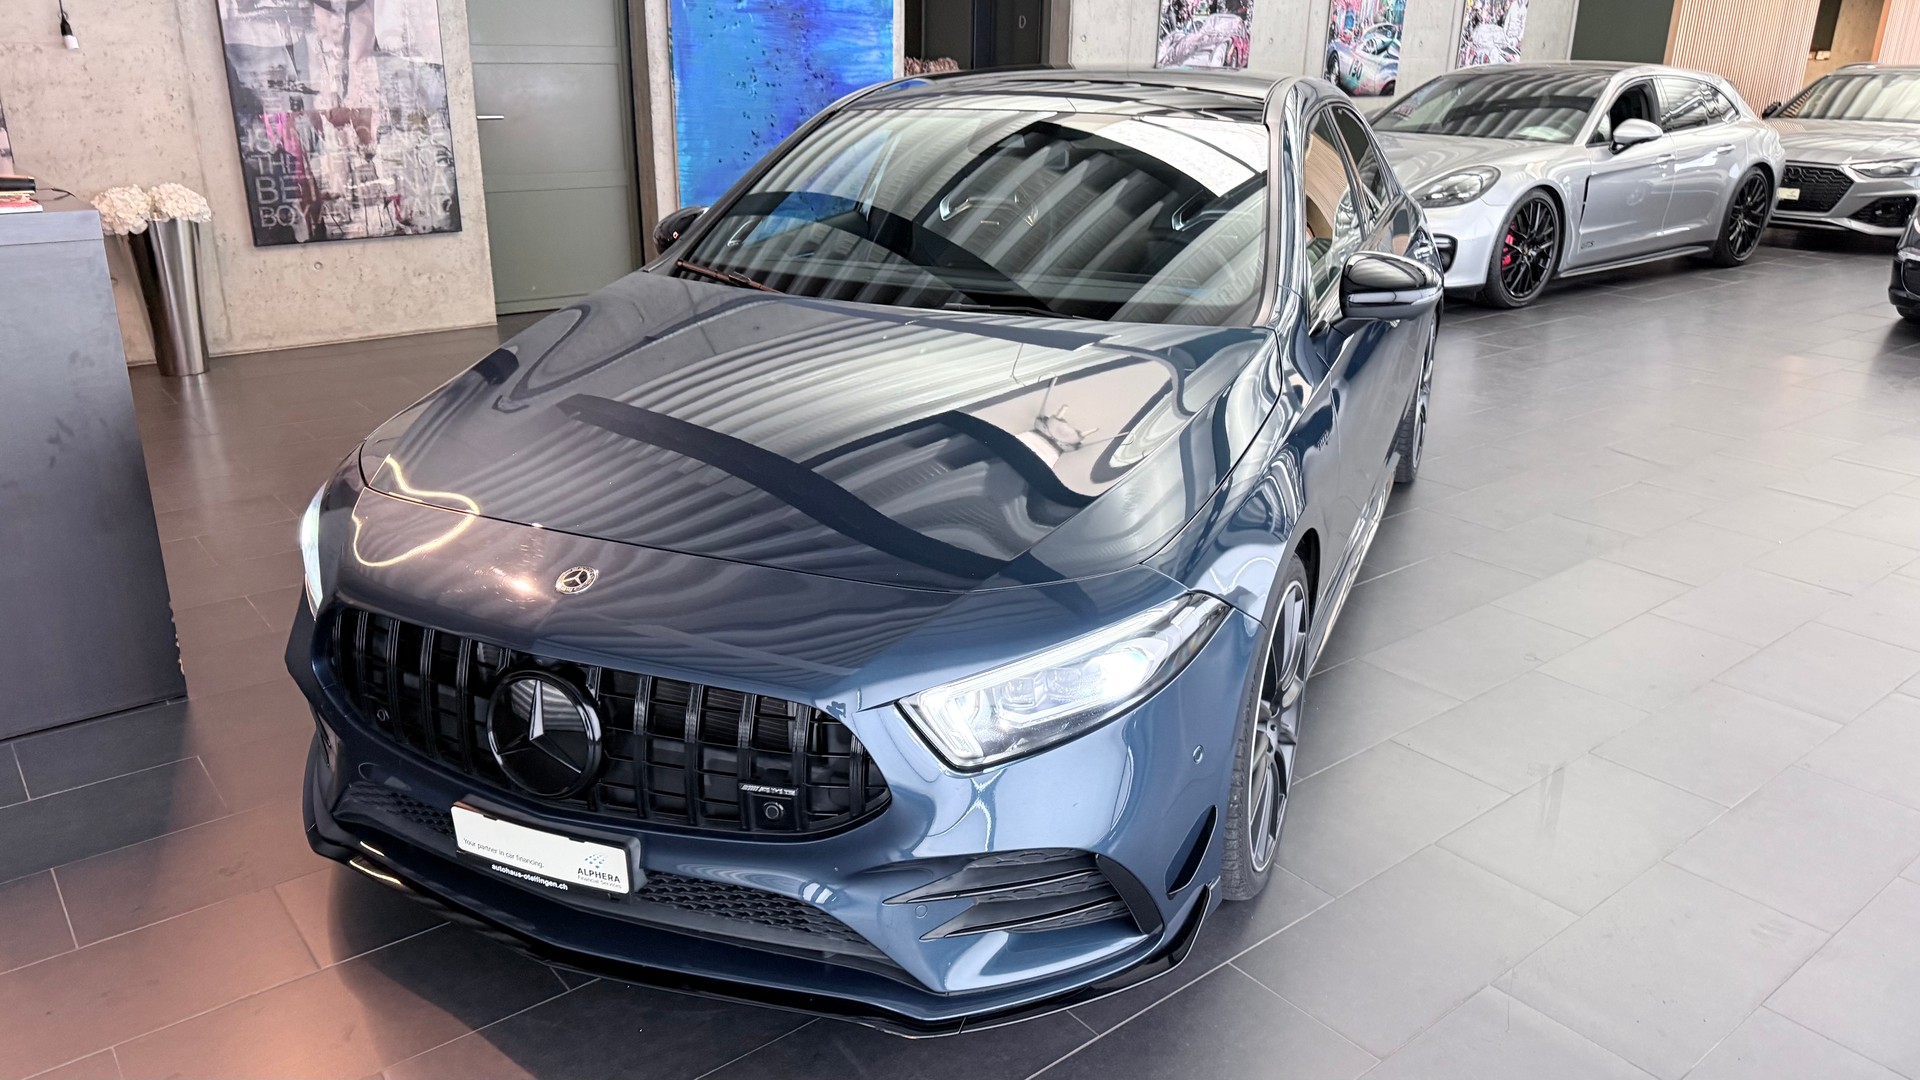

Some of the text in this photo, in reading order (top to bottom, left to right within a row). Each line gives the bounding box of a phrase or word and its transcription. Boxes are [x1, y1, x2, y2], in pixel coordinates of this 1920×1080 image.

[250, 152, 303, 175] THE
[463, 837, 476, 847] Your
[477, 843, 497, 854] partner
[577, 867, 621, 883] ALPHERA
